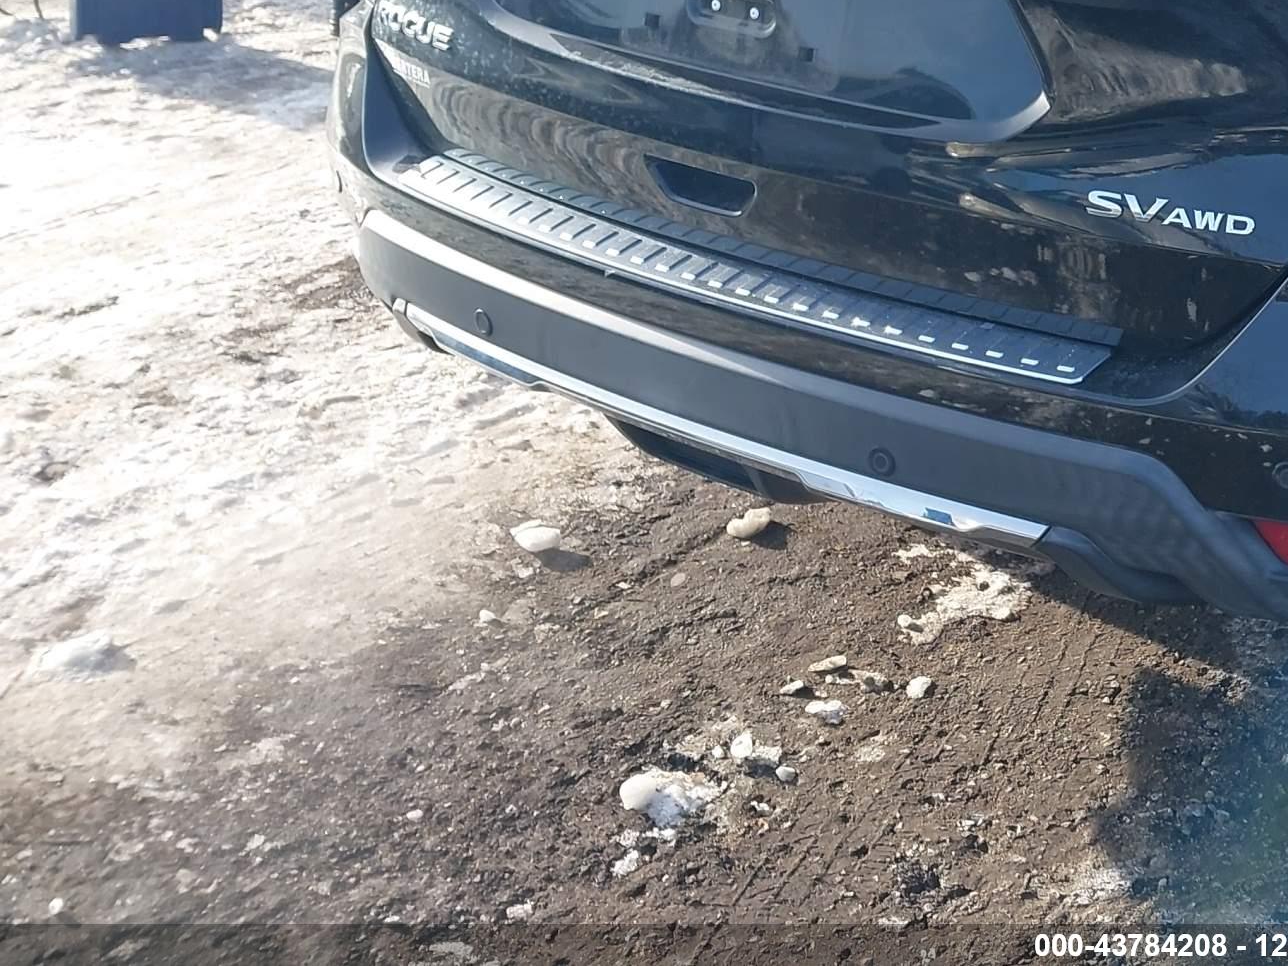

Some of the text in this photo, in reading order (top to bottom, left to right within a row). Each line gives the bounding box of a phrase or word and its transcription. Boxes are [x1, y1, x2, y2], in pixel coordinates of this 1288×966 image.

[377, 0, 454, 51] ROGUE
[1086, 190, 1256, 235] SV AWD
